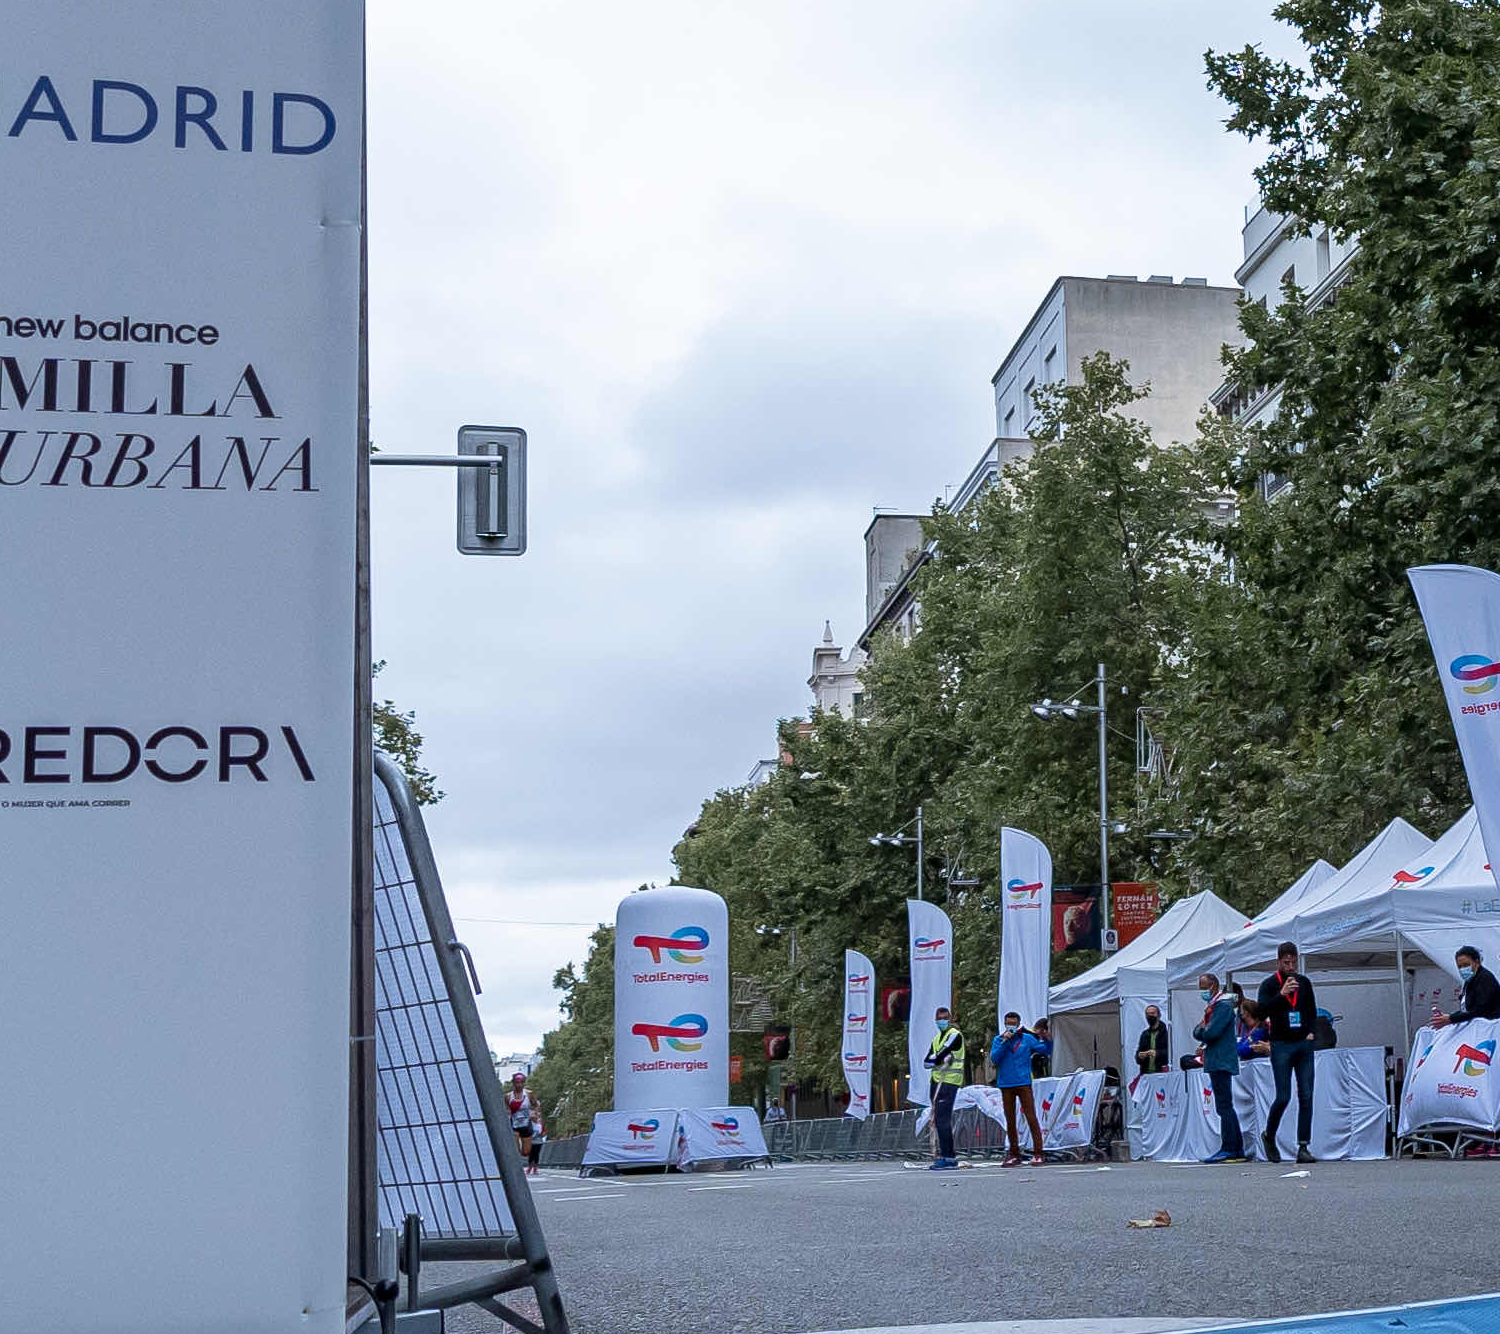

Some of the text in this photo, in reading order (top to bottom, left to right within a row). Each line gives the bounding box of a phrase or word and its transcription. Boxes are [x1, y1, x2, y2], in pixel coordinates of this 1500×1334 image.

[74, 315, 219, 345] balance
[632, 972, 709, 983] TotalEnergies
[631, 1060, 708, 1072] TotalEnergies
